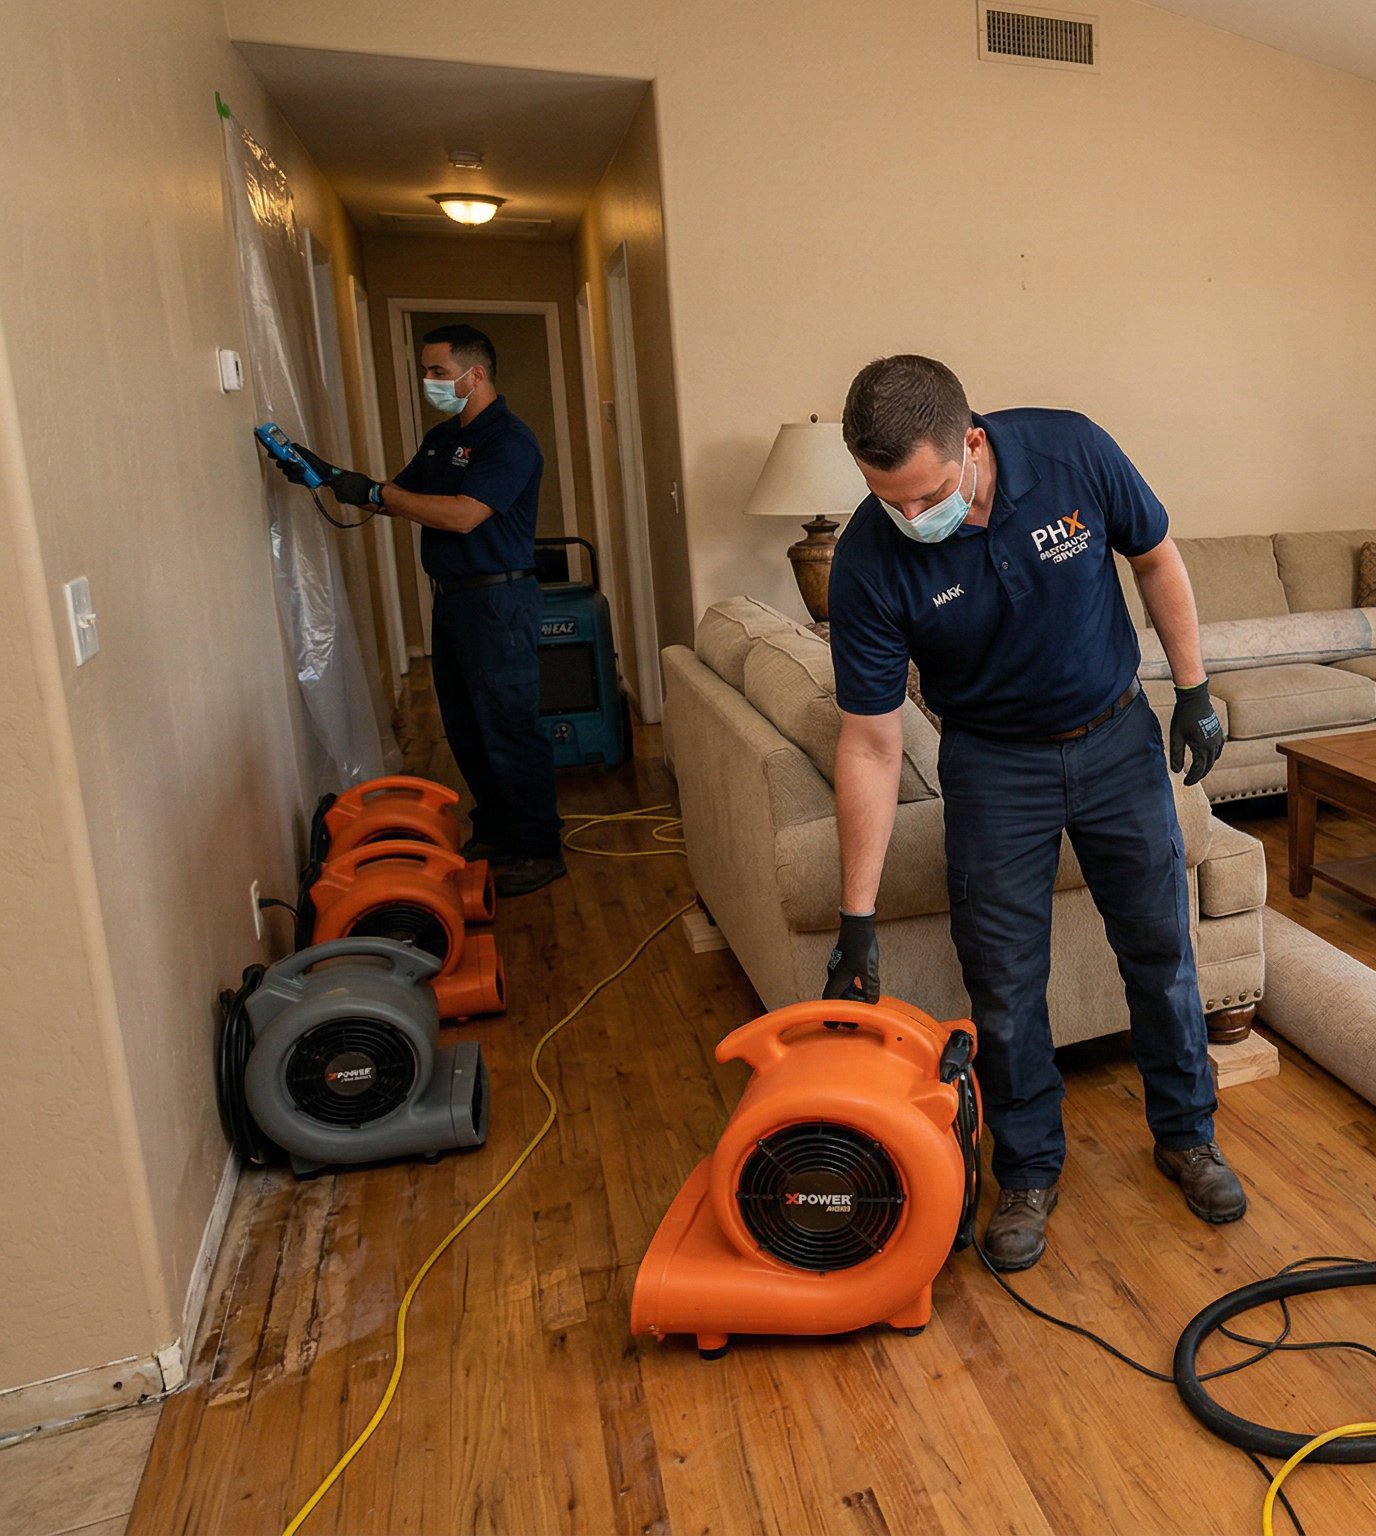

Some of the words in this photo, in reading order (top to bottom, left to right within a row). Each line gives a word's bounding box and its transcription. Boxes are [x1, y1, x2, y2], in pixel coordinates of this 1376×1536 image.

[1031, 509, 1086, 552] PHX
[932, 583, 965, 607] MARK
[785, 1193, 852, 1205] XPOWER
